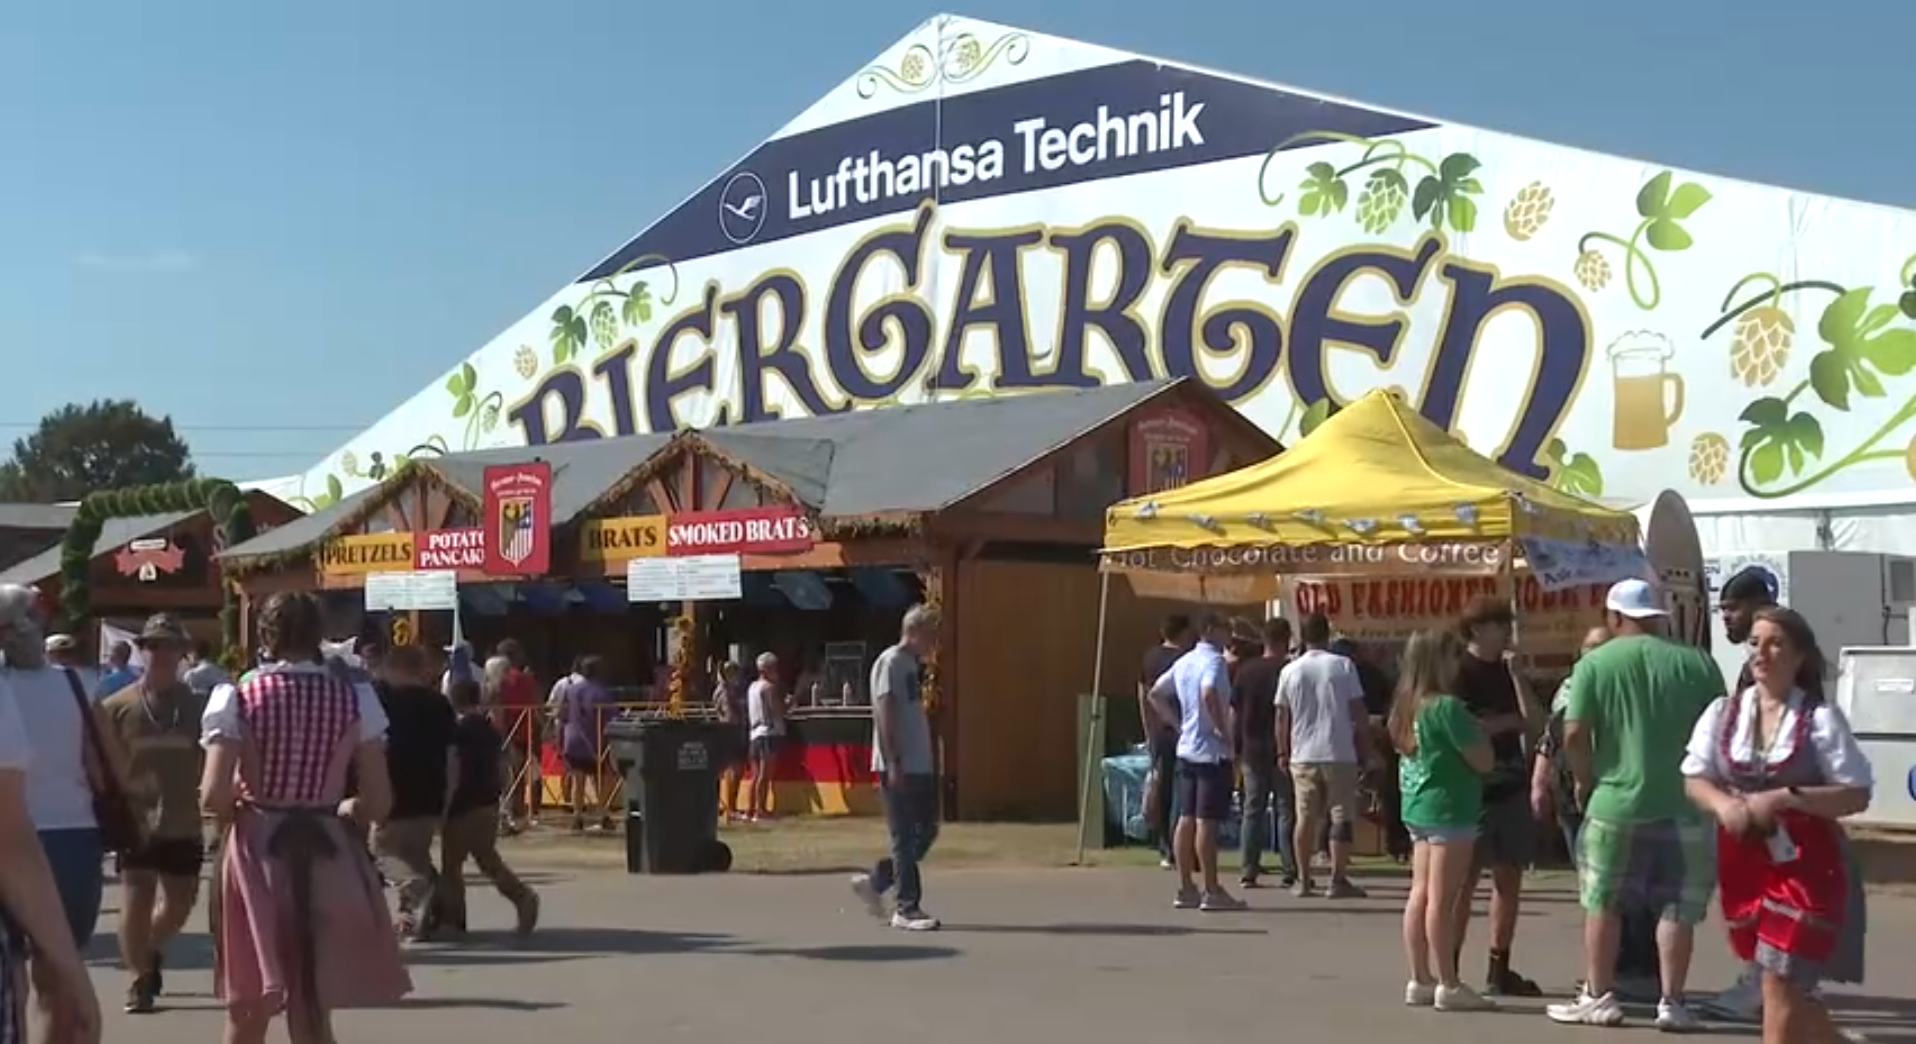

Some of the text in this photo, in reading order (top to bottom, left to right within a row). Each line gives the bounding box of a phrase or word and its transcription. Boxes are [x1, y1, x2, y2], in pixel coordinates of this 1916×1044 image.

[788, 91, 1206, 220] Lufthansa Technik
[506, 200, 1593, 478] BIERGARTEN
[588, 525, 658, 549] BRATS
[668, 515, 809, 547] SMOKED BRATS
[325, 541, 412, 566] PRETZELS
[420, 547, 485, 567] PANCAK
[1170, 545, 1318, 568] Chocolate
[1330, 542, 1384, 563] and
[1397, 543, 1500, 564] Coffee
[1296, 582, 1342, 616] OLD
